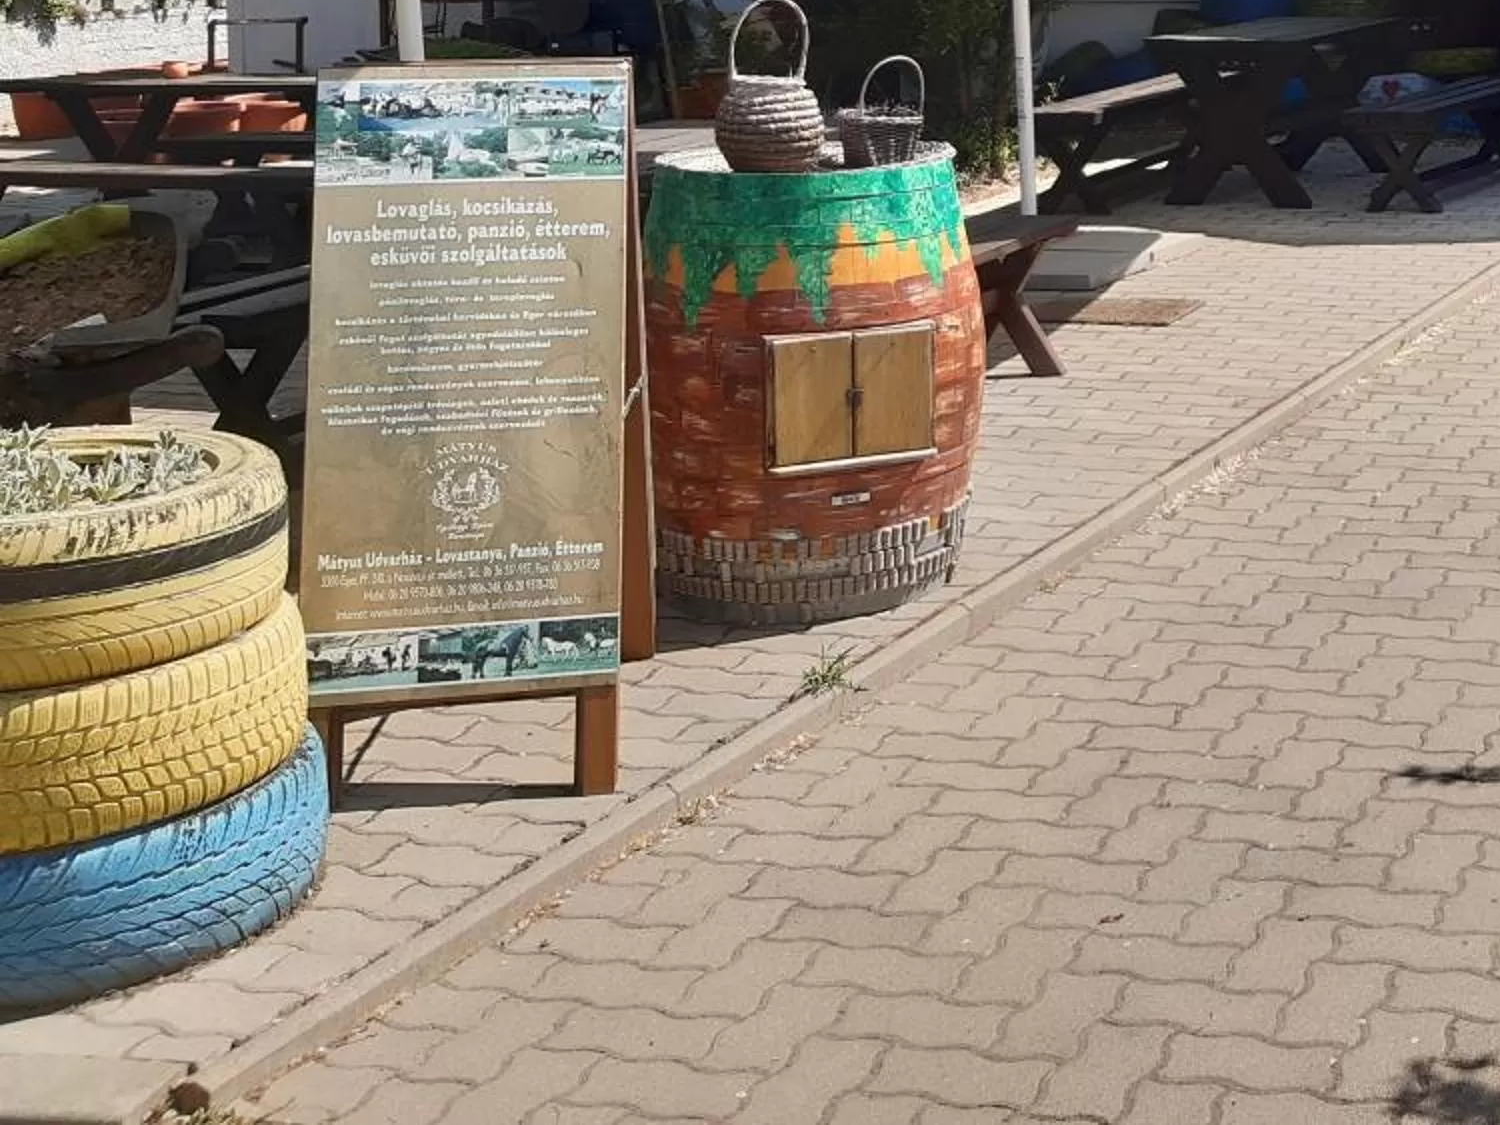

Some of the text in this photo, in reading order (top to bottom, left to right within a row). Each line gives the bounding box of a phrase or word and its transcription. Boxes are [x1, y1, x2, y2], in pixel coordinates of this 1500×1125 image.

[376, 196, 559, 221] Lovaglás, kocsikázás,
[326, 219, 611, 244] lovasbemutató, panzió, étterem,
[441, 241, 567, 266] szolgáltatások
